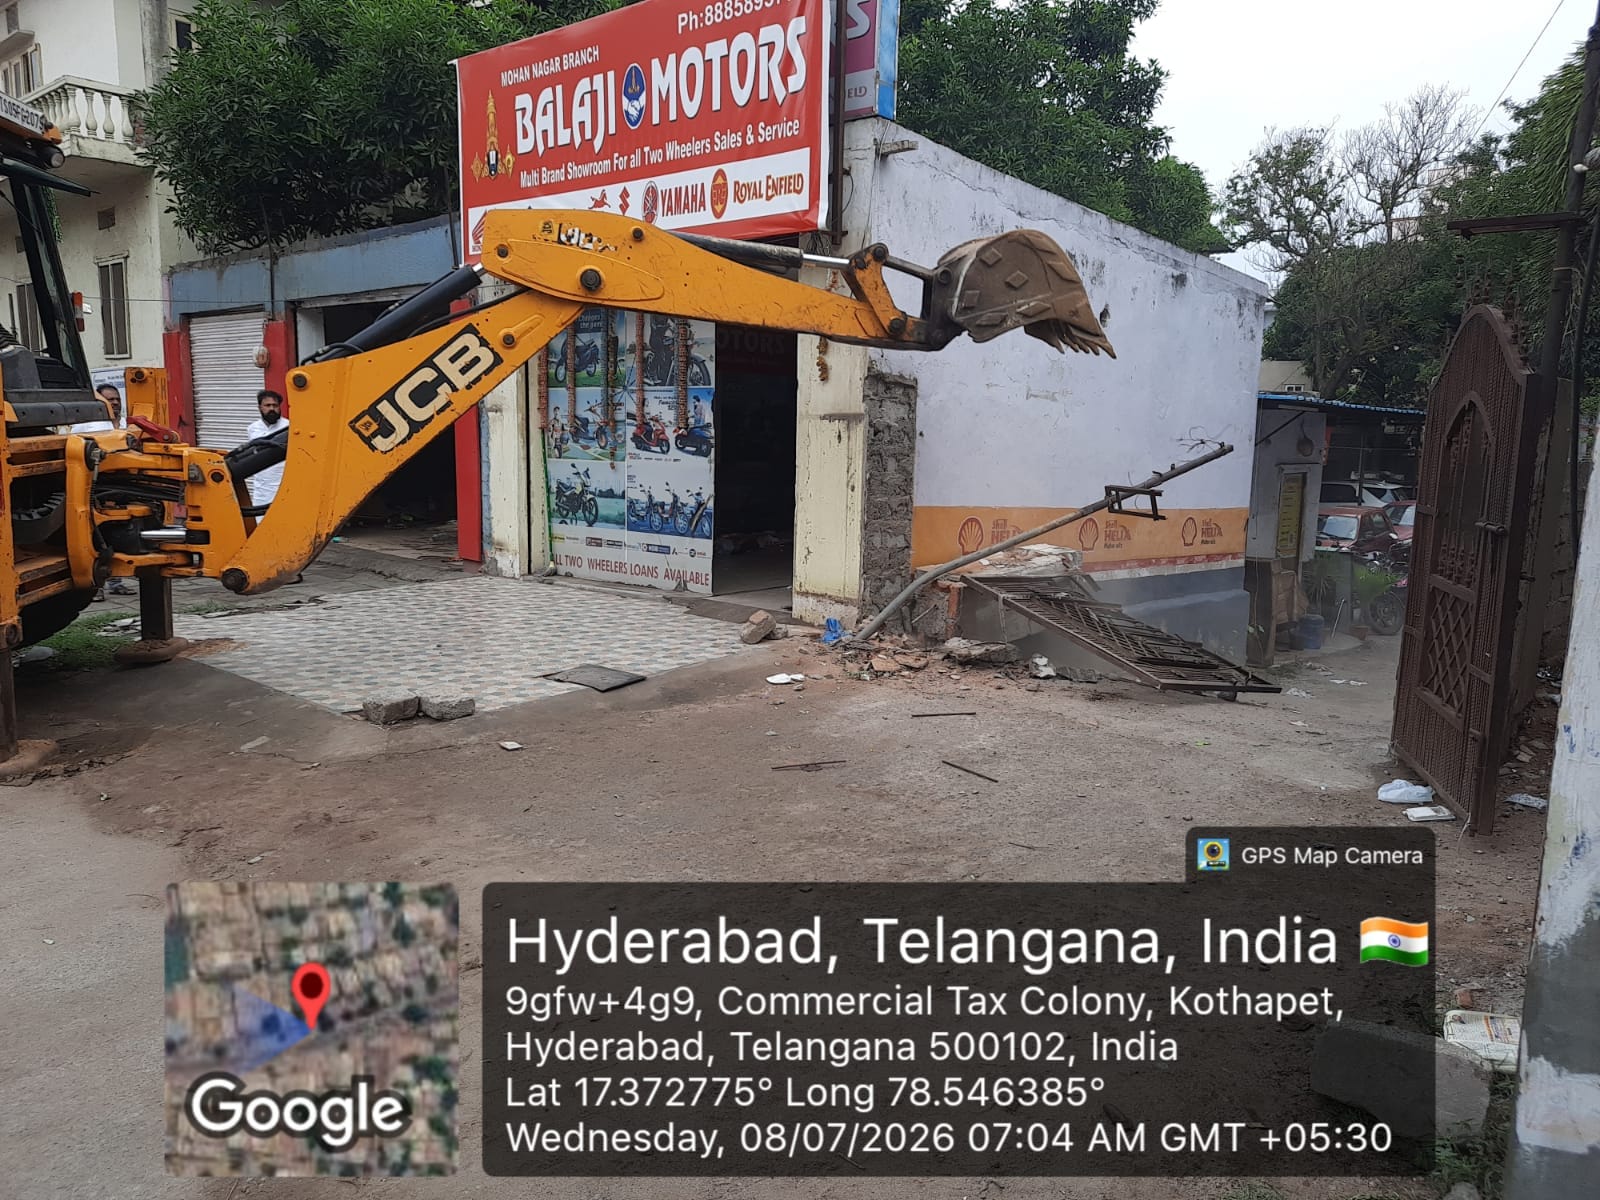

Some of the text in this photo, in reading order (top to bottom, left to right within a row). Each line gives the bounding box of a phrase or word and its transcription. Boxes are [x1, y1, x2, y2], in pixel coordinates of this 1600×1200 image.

[501, 44, 599, 87] MOHAN NAGAR BRANCH
[515, 16, 807, 157] BALAJI MOTORS
[847, 85, 867, 98] ELD
[520, 118, 799, 188] Multi Brand Showroom For all Two Wheelers Sales & Service
[660, 182, 706, 217] YAMAHA
[733, 173, 804, 204] ROYAL ENFIELD
[371, 333, 495, 452] JCB
[553, 553, 709, 586] LL TWO WHEELERS LOANS AVAILABLE
